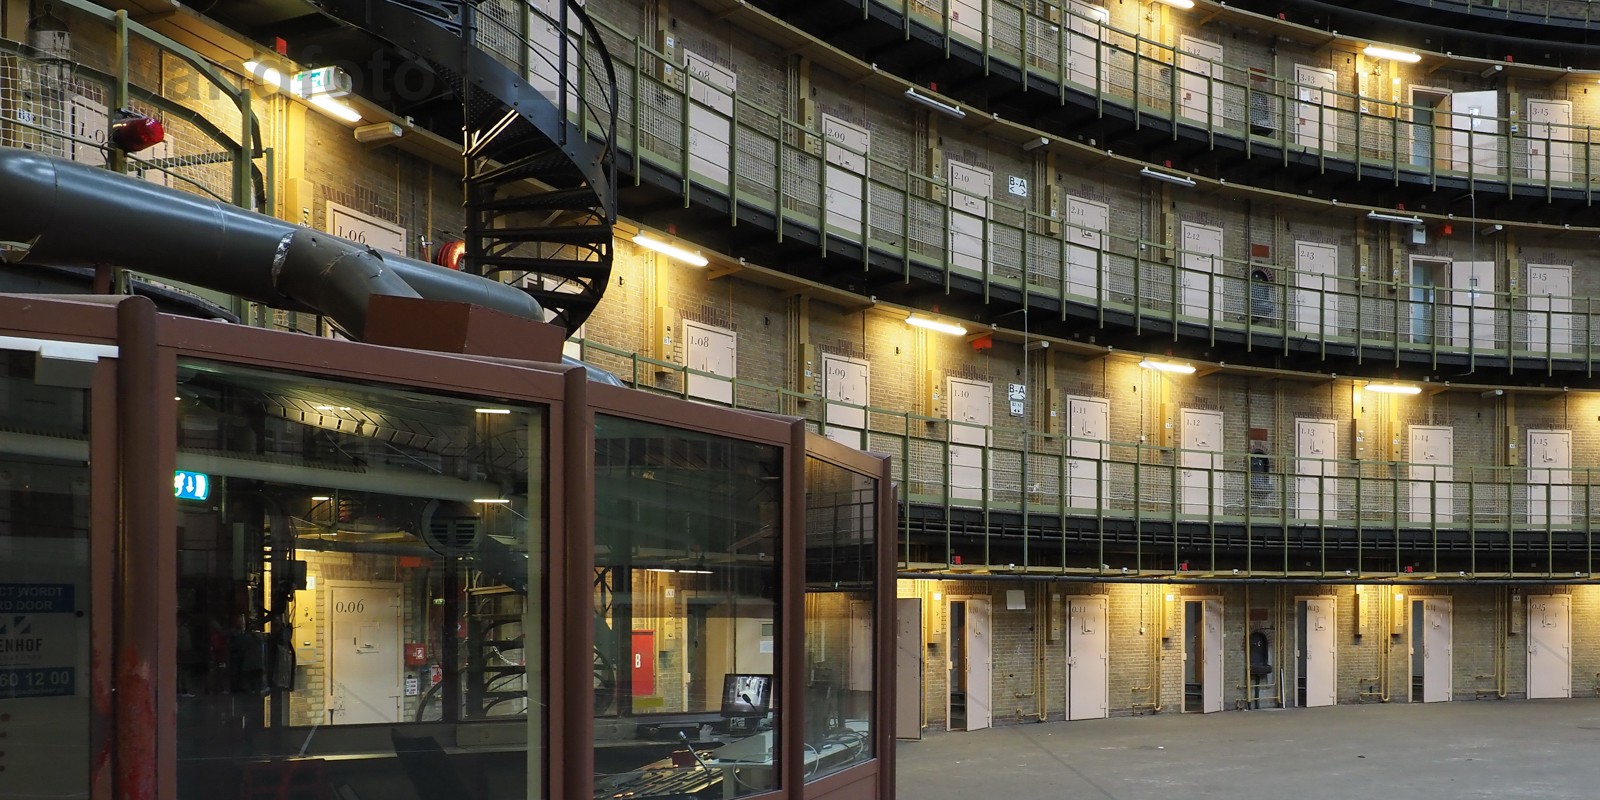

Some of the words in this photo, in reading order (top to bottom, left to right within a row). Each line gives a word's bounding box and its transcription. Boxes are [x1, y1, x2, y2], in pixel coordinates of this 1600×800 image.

[1299, 73, 1315, 84] 3.13
[1532, 107, 1549, 117] 3.15
[827, 127, 846, 142] 2.09
[953, 172, 970, 184] 2.10
[1070, 206, 1084, 216] 2.11
[338, 225, 366, 245] 1.06
[1186, 231, 1200, 241] 2.12
[1299, 250, 1315, 261] 2.13
[1532, 272, 1547, 283] 2.15
[690, 335, 710, 348] 1.08
[828, 366, 846, 379] 1.09
[953, 390, 970, 399] 1.10
[1072, 406, 1086, 415] 1.11
[1186, 418, 1200, 427] 1.12
[1301, 428, 1315, 438] 1.13
[1414, 434, 1429, 443] 1.14
[1533, 438, 1548, 448] 1.15
[18, 586, 64, 598] WORDT
[16, 600, 53, 611] DOOR
[335, 600, 365, 614] 0.06
[1071, 606, 1086, 614] 0.11
[1532, 604, 1547, 614] 0.15
[25, 671, 45, 686] 12
[50, 670, 70, 685] 00
